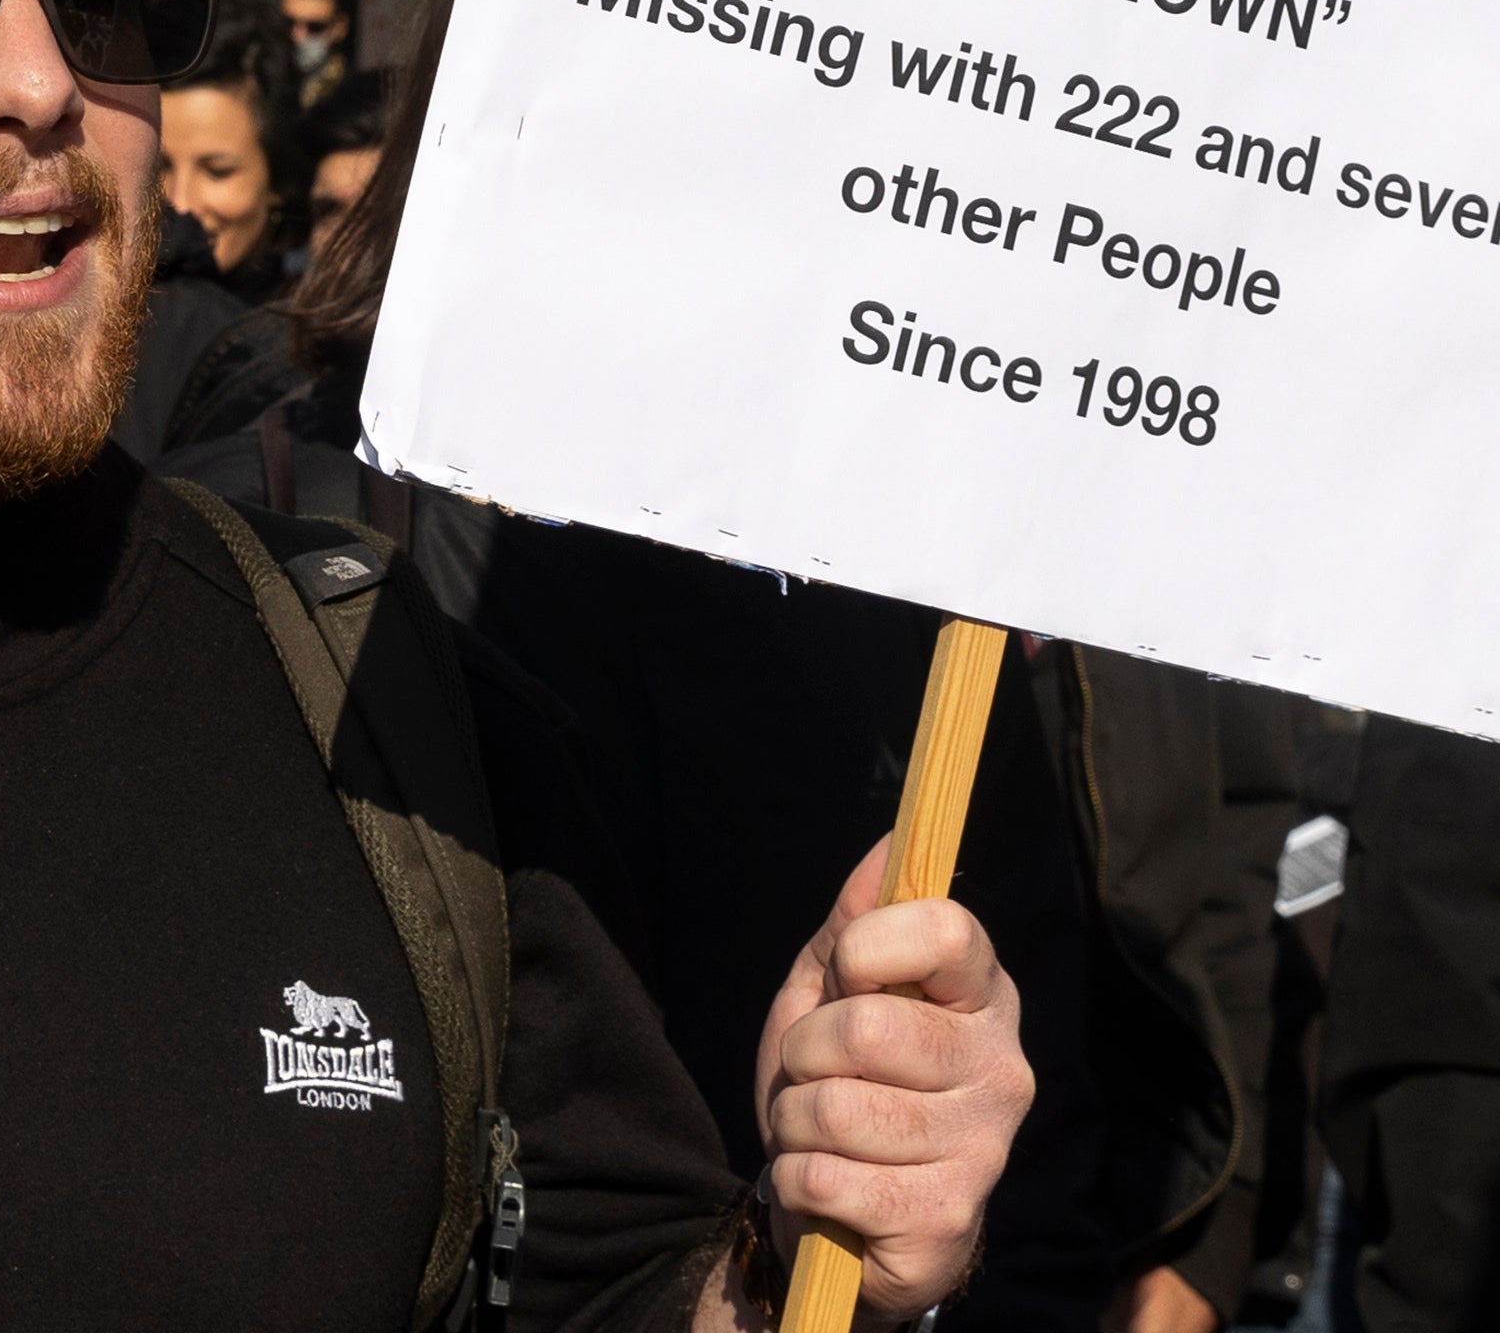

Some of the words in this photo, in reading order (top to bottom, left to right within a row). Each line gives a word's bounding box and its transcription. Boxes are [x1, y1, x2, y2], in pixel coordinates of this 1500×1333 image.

[891, 40, 1036, 122] with
[1054, 74, 1180, 159] 222
[1195, 125, 1321, 195] and
[841, 164, 1037, 251] other
[1053, 203, 1280, 315] People
[842, 300, 1042, 403] Since
[1072, 358, 1220, 446] 1998
[259, 1026, 403, 1098] LONSDALE
[297, 1087, 373, 1112] LONDON
